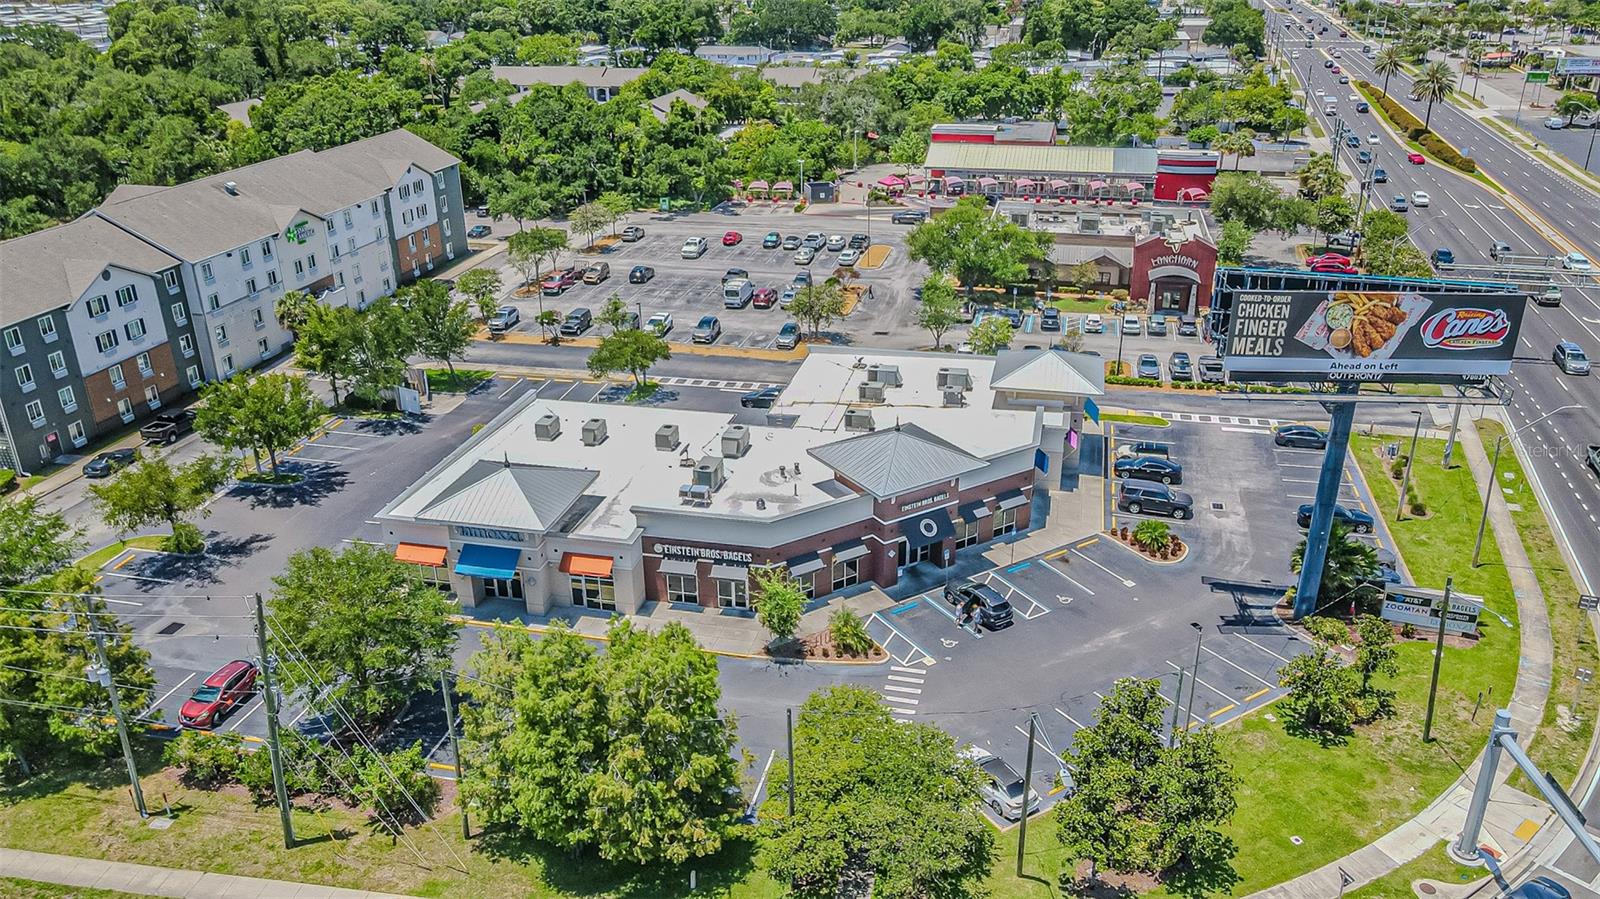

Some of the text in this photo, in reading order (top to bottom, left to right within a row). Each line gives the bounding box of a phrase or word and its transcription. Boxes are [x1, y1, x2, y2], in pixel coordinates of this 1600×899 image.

[1151, 255, 1198, 268] LONGHORN
[1240, 294, 1292, 303] COOKED-TO-ORDER
[1238, 303, 1290, 318] CHICKEN
[1457, 311, 1487, 320] Raising
[1235, 319, 1288, 337] FINGER
[1424, 308, 1507, 345] Cane's
[1231, 337, 1284, 356] MEALS
[1330, 362, 1361, 370] Ahead
[1379, 362, 1398, 370] Left
[664, 544, 699, 557] EINSTEIN
[724, 551, 752, 562] BAGELS
[1404, 596, 1424, 605] AT&T
[1452, 603, 1477, 613] BAGELS
